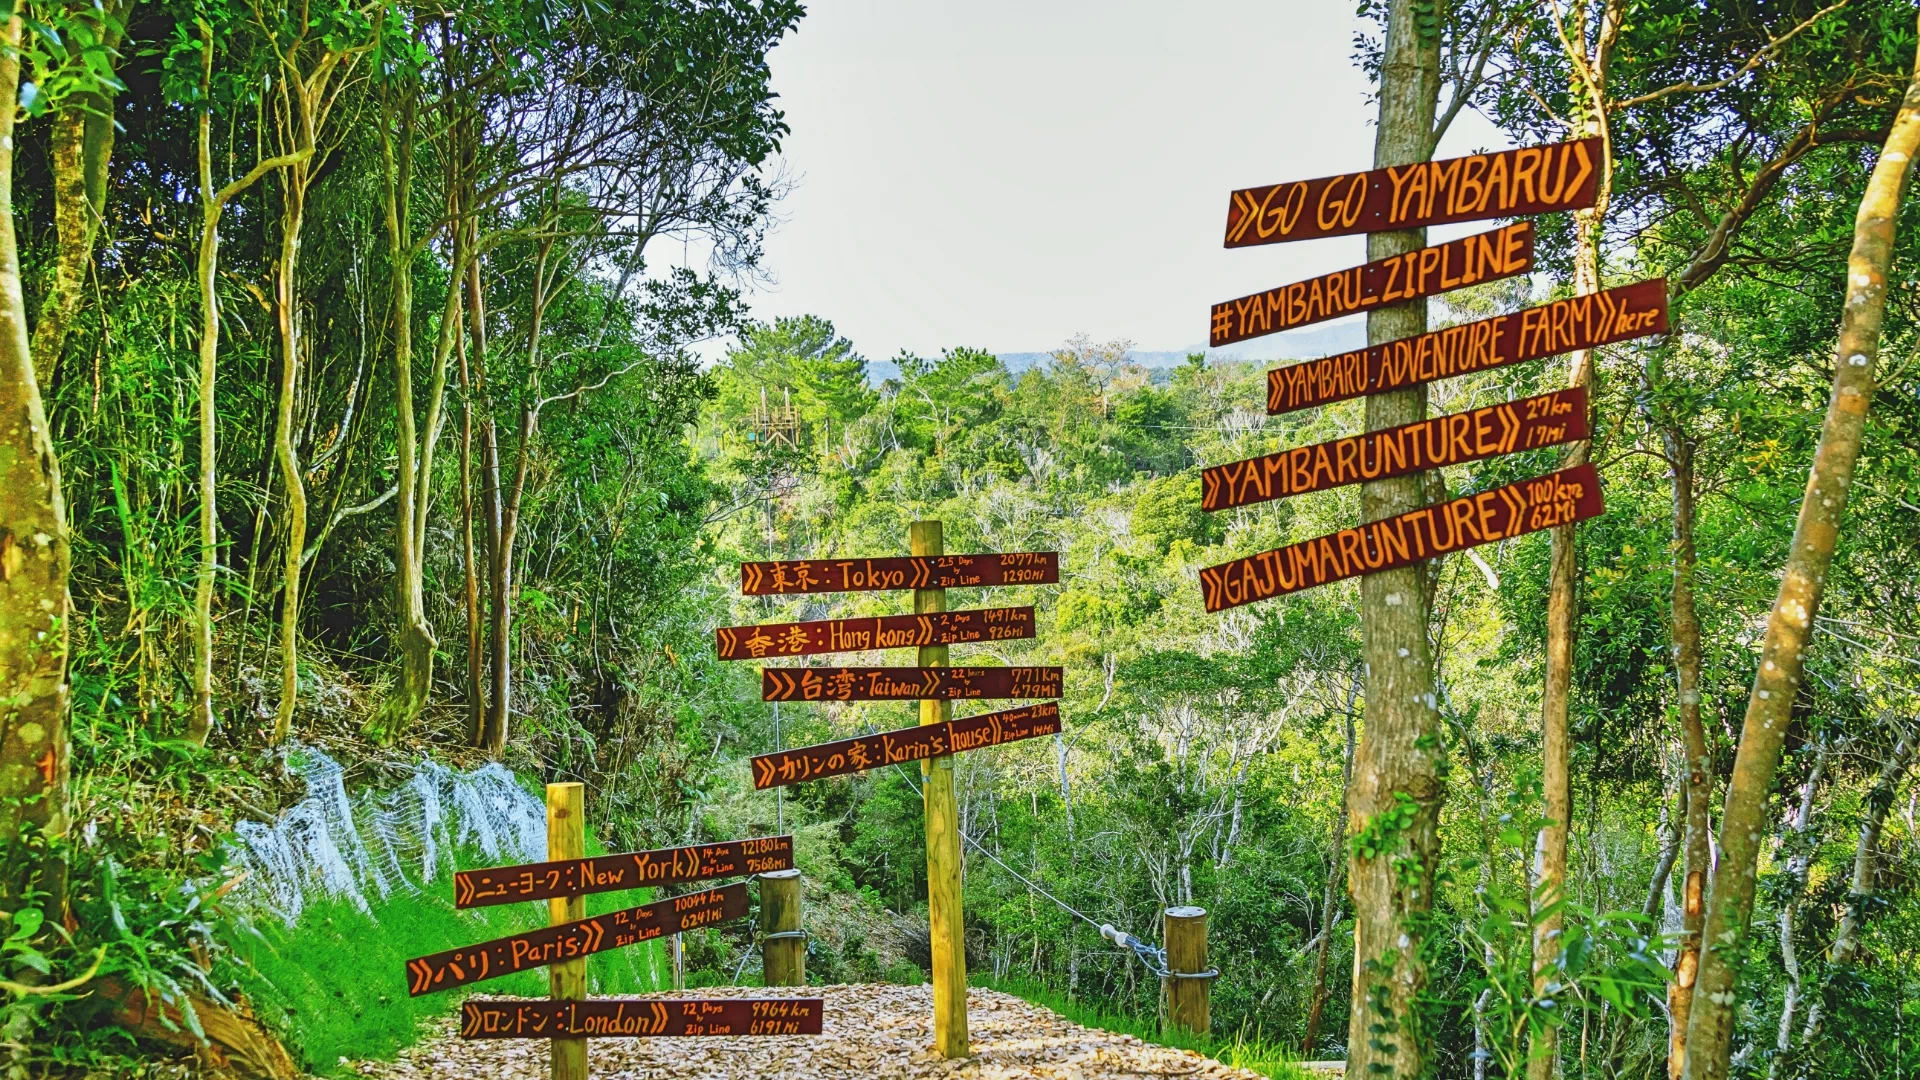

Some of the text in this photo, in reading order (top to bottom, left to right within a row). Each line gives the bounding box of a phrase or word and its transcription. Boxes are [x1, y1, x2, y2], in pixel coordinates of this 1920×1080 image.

[1256, 144, 1572, 238] GO GO YAMBARU
[1284, 294, 1660, 408] YAMBARU ADVENTURE FARM here
[1222, 407, 1496, 498] YAMBARUNTURE
[1223, 491, 1501, 605] GAJUMARUNTURE
[938, 556, 974, 568] 2.5 Days
[836, 560, 905, 590] Tokyo
[940, 575, 981, 587] Zip Line
[940, 614, 971, 625] 2 Days
[830, 621, 870, 650] Hong
[940, 631, 981, 643] Zip Line
[867, 671, 920, 697] Taiwan
[951, 669, 965, 679] 22
[947, 687, 981, 698] Zip Line
[882, 735, 945, 764] Karin's
[947, 721, 991, 751] house
[1003, 729, 1029, 741] Zip Line
[580, 861, 624, 888] New
[634, 850, 685, 881] York
[701, 864, 735, 876] Zip Line
[614, 912, 630, 925] 12
[615, 926, 661, 947] Zip Line
[511, 935, 578, 969] Paris
[569, 1003, 650, 1035] London
[682, 1002, 723, 1015] 12 Days
[685, 1024, 731, 1036] Zip Line
